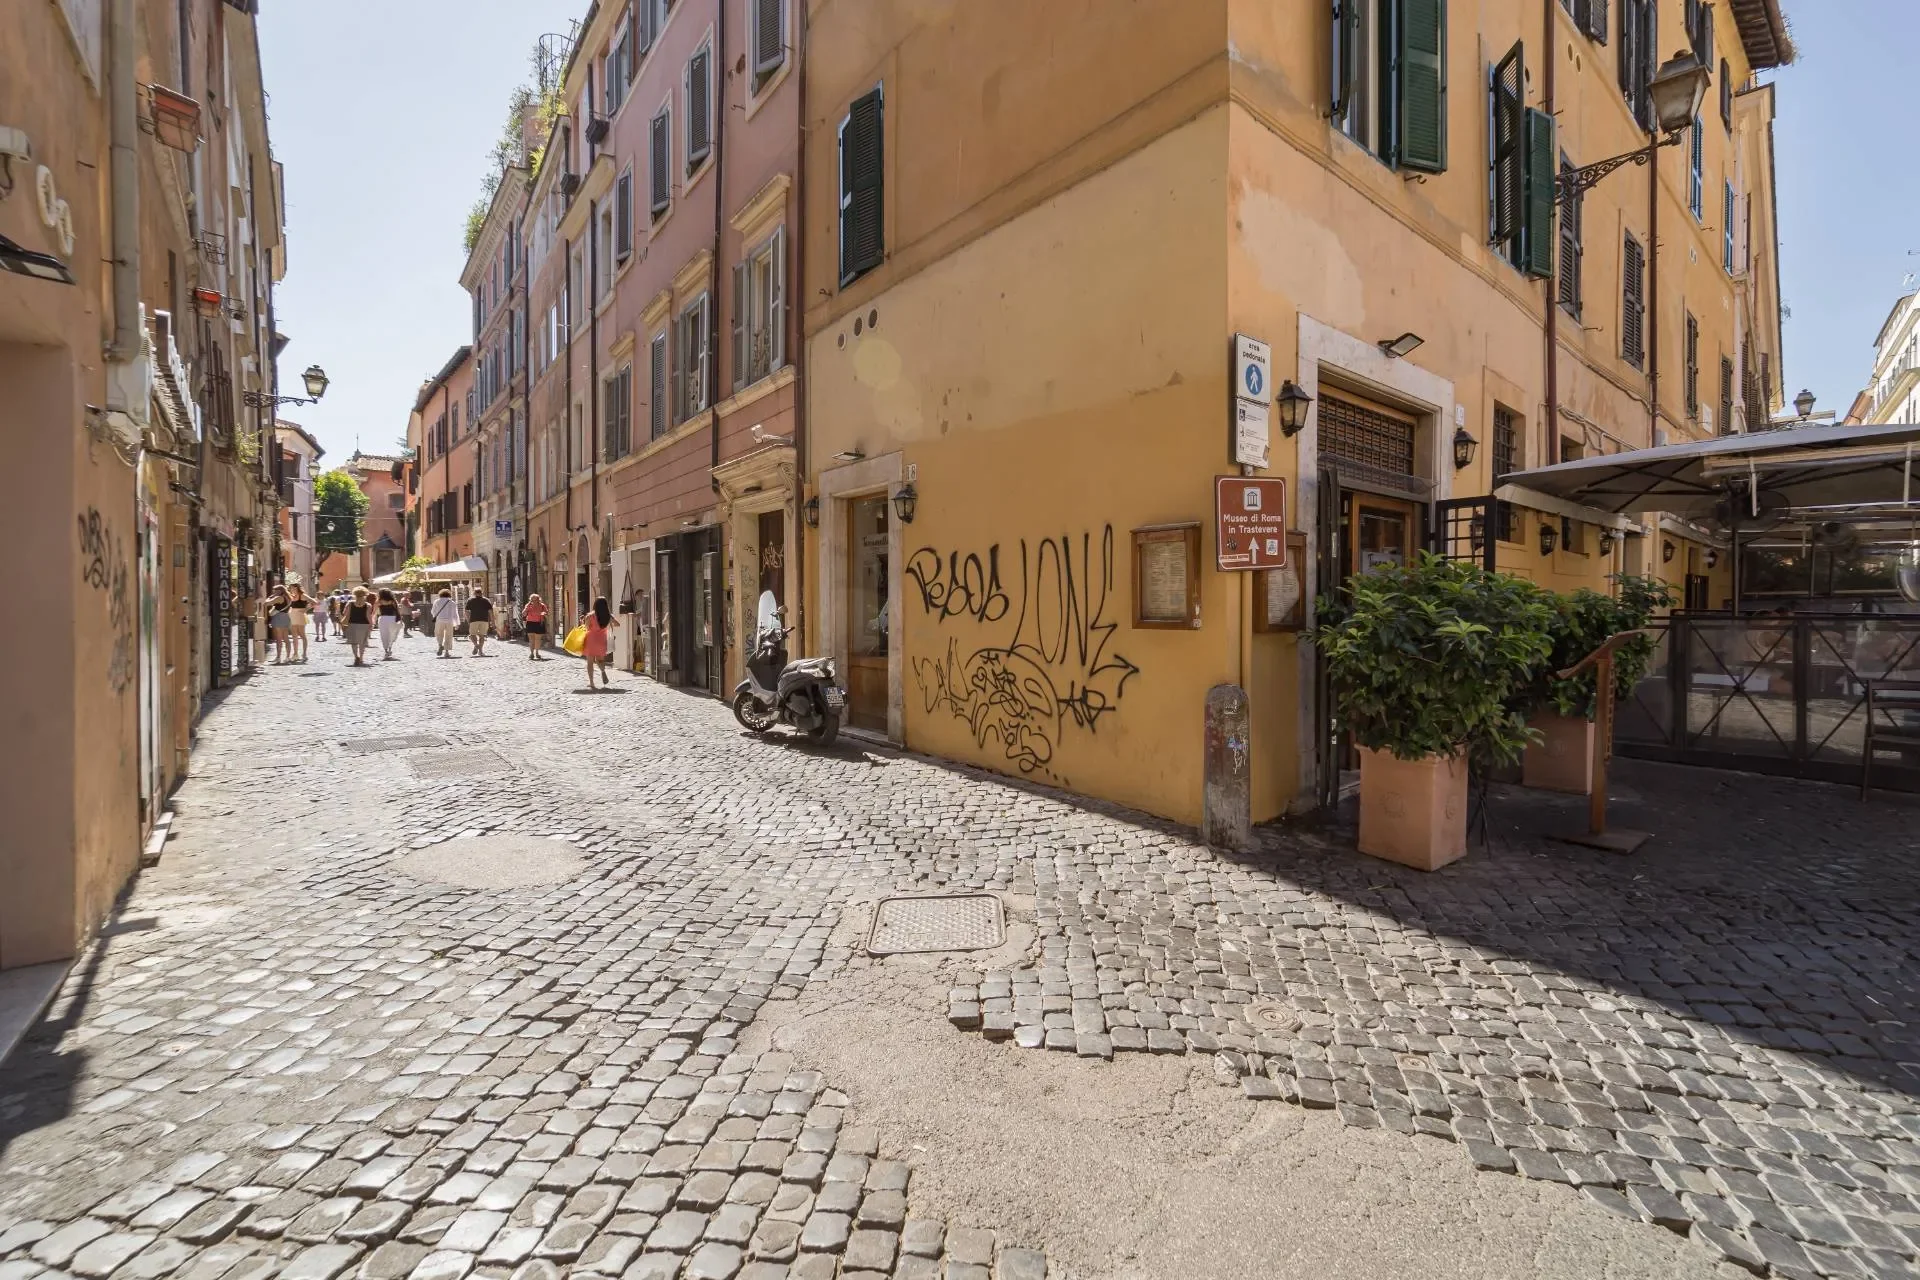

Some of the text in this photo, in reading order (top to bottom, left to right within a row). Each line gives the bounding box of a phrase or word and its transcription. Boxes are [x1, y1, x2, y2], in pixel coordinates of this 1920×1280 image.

[1242, 351, 1266, 365] pedonale
[1223, 513, 1282, 523] Museo di Roma
[1228, 524, 1278, 534] in Trastevere
[217, 548, 231, 669] MURANO GLASS
